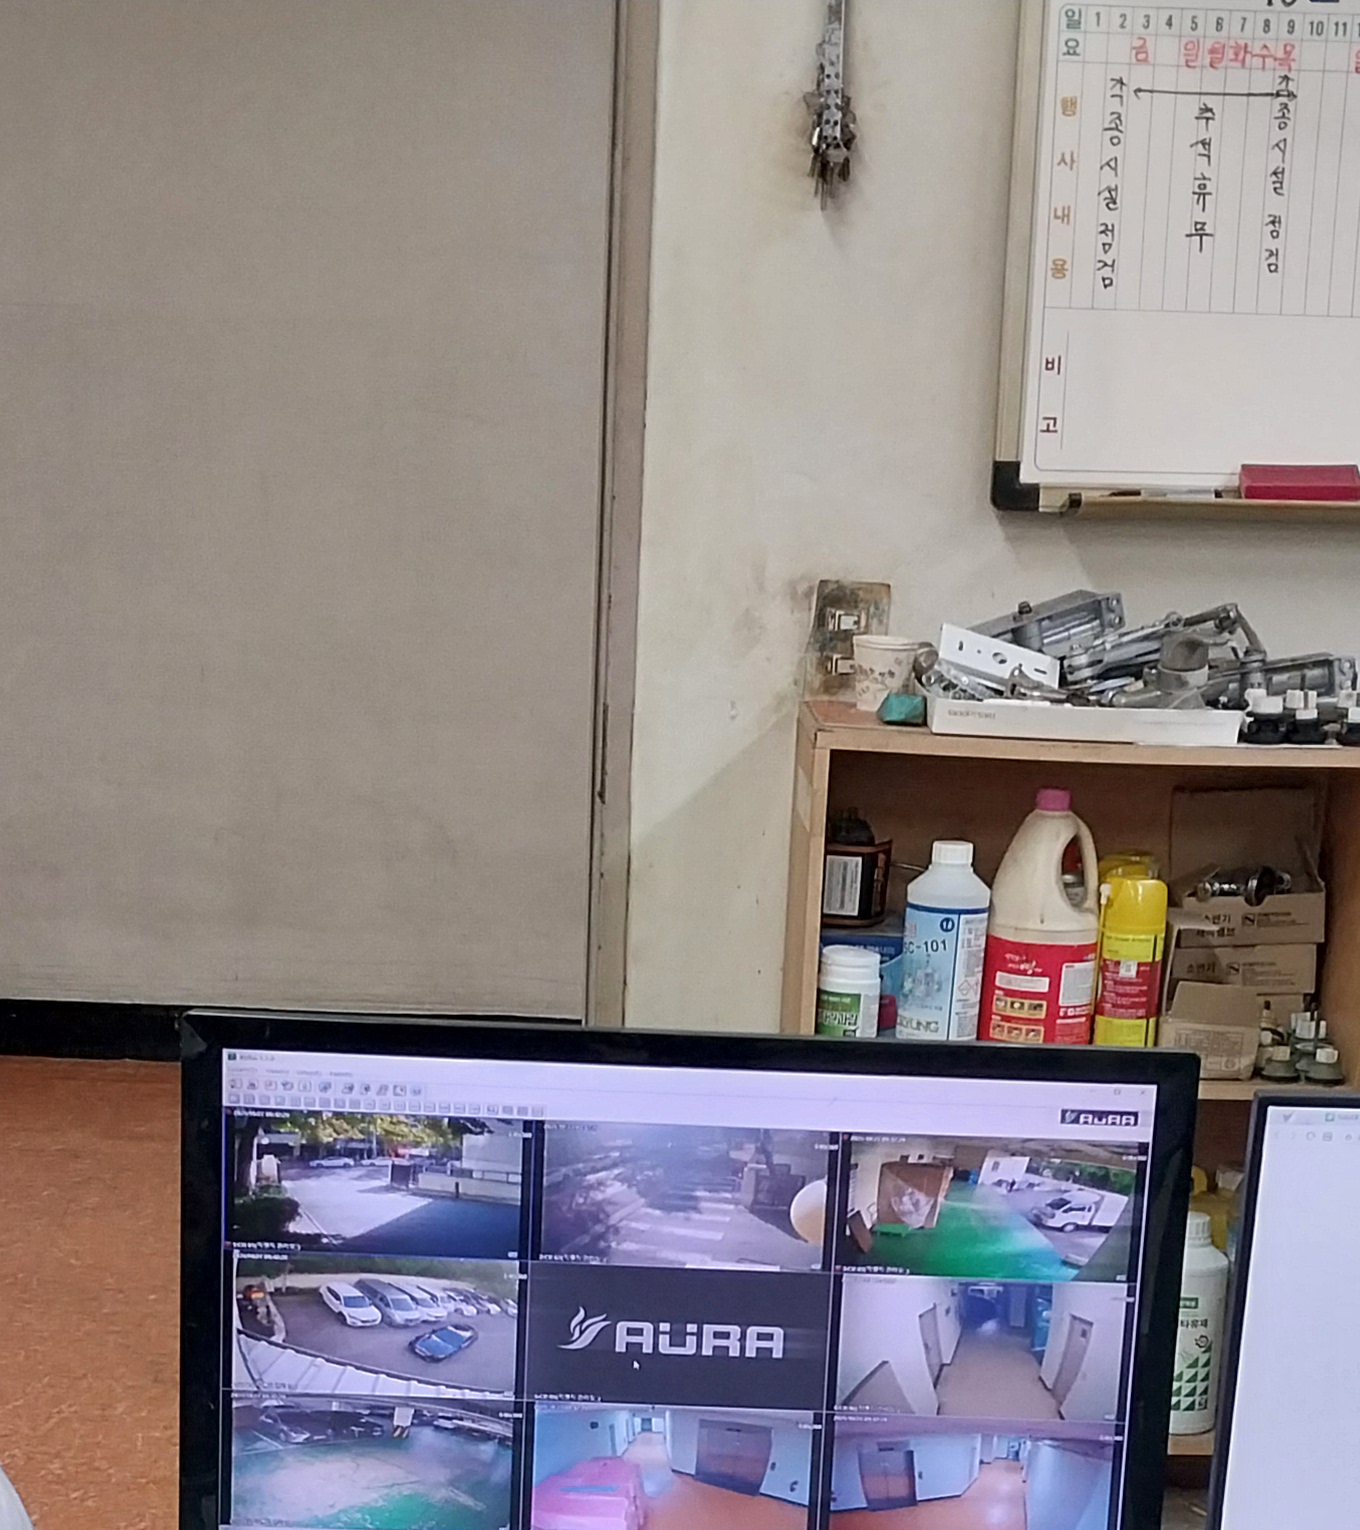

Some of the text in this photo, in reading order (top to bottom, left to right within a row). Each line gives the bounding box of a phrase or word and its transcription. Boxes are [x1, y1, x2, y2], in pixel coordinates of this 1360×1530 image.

[1065, 8, 1082, 29] 일
[1095, 12, 1101, 27] 1
[1119, 14, 1128, 28] 2
[1142, 15, 1150, 29] 3
[1165, 15, 1173, 29] 4
[1190, 16, 1198, 31] 5
[1215, 17, 1224, 32] 6
[1239, 18, 1247, 33] 7
[1262, 19, 1271, 33] 8
[1287, 19, 1295, 34] 9
[1308, 21, 1324, 36] 10
[1334, 21, 1348, 37] 11
[1061, 38, 1081, 56] 요
[1182, 38, 1200, 69] 일
